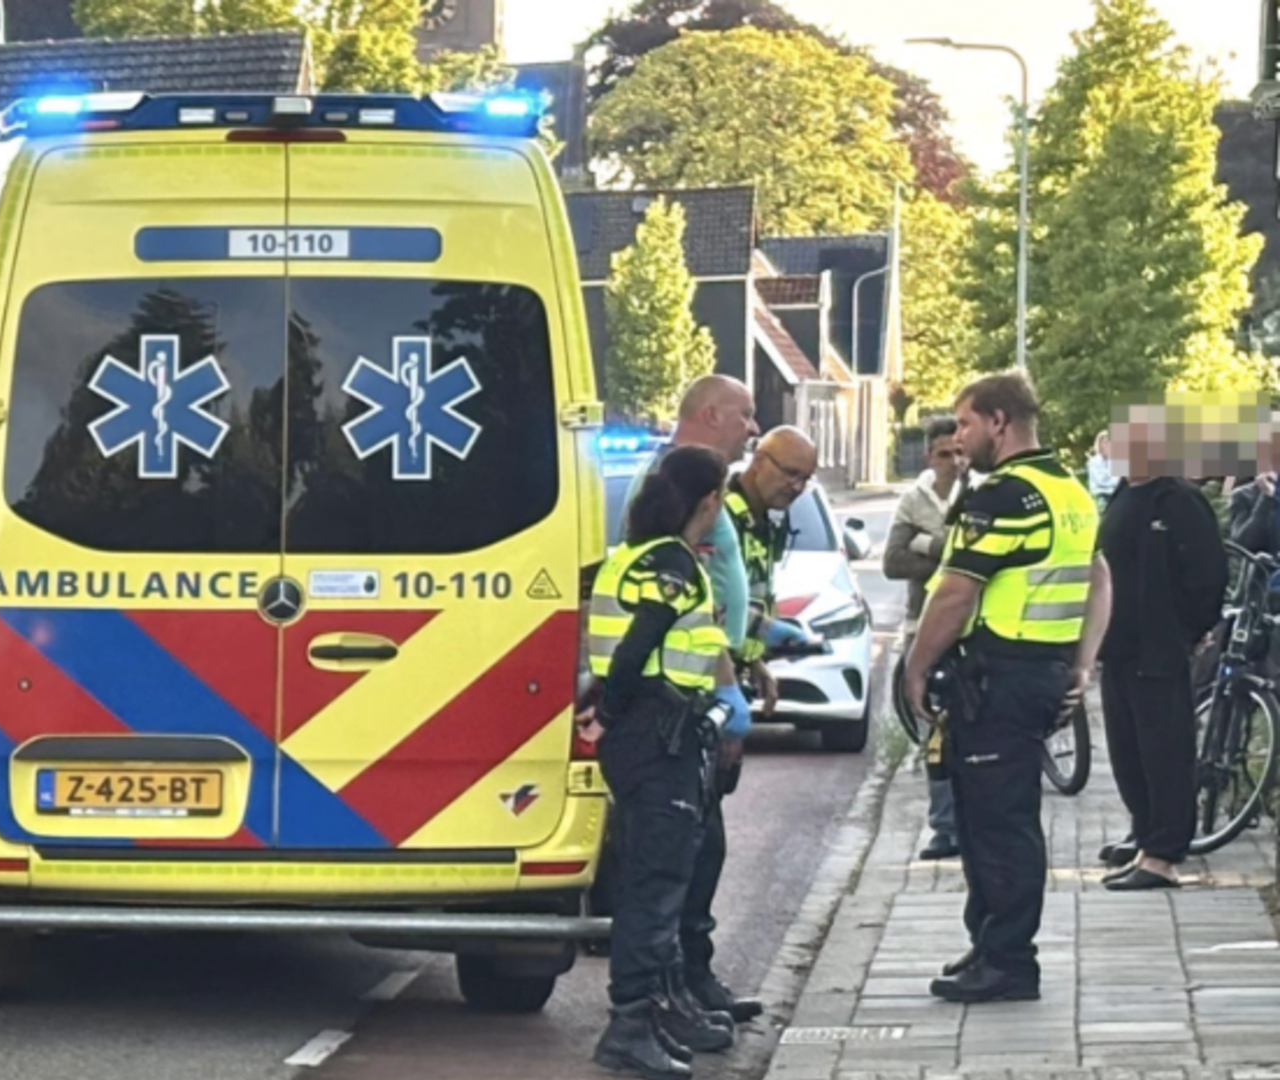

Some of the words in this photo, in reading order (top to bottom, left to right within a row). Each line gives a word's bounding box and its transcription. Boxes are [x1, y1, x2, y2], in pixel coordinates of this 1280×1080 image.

[247, 233, 333, 254] 10-110
[393, 571, 512, 600] 10-110
[67, 776, 207, 803] Z-425-BT
